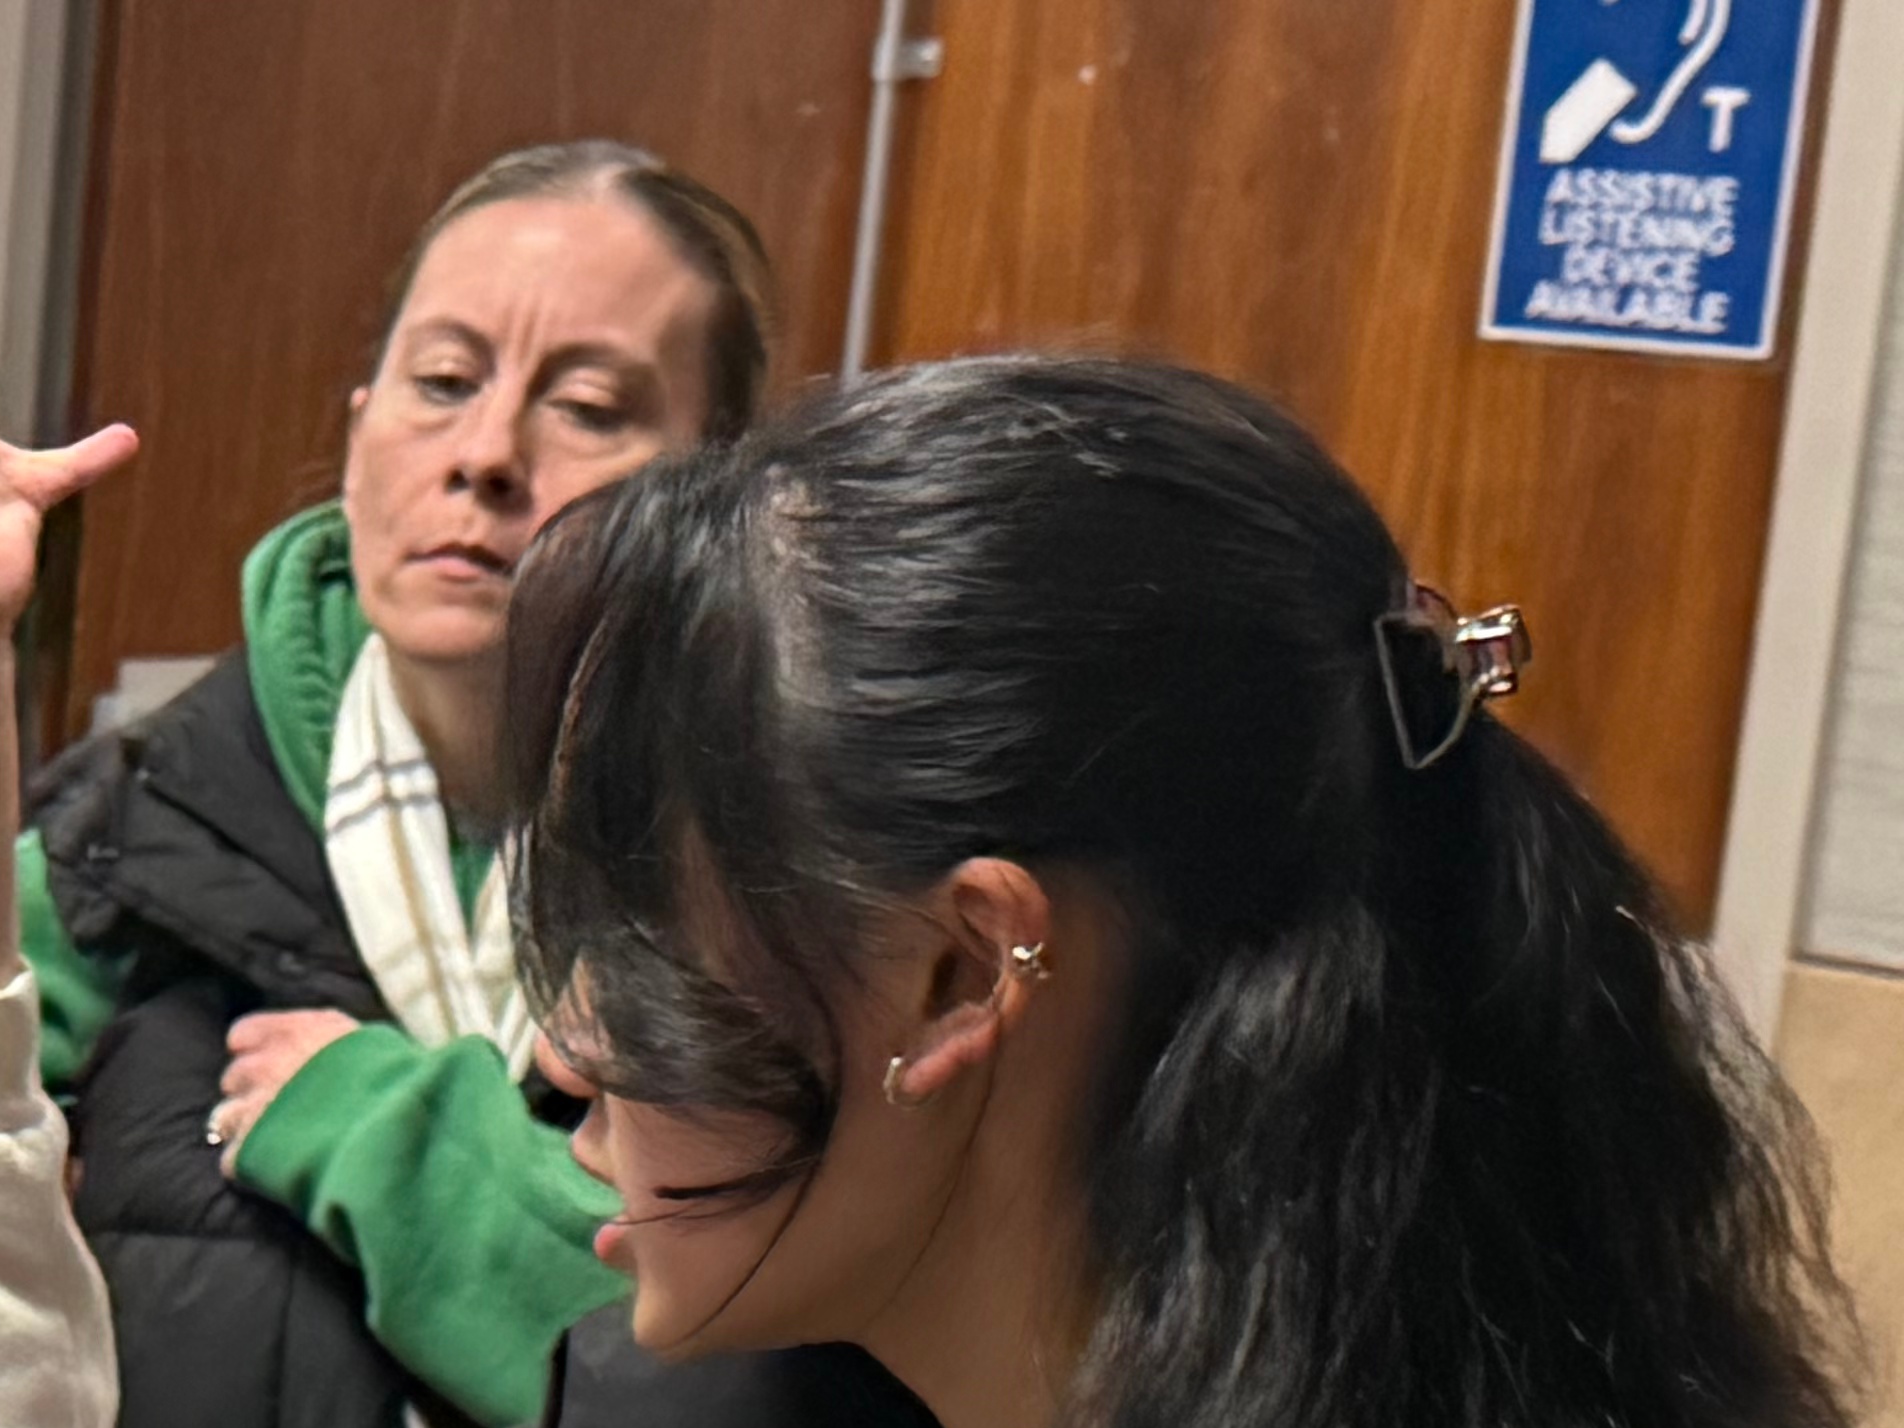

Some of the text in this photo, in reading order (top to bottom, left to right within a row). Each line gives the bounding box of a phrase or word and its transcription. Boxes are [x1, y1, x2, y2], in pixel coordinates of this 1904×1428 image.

[1701, 86, 1750, 152] T
[1545, 168, 1740, 215] ASSISTIVE
[1539, 203, 1735, 256] LISTENING
[1560, 242, 1701, 291] DEVICE
[1525, 281, 1731, 333] AVAILABLE
